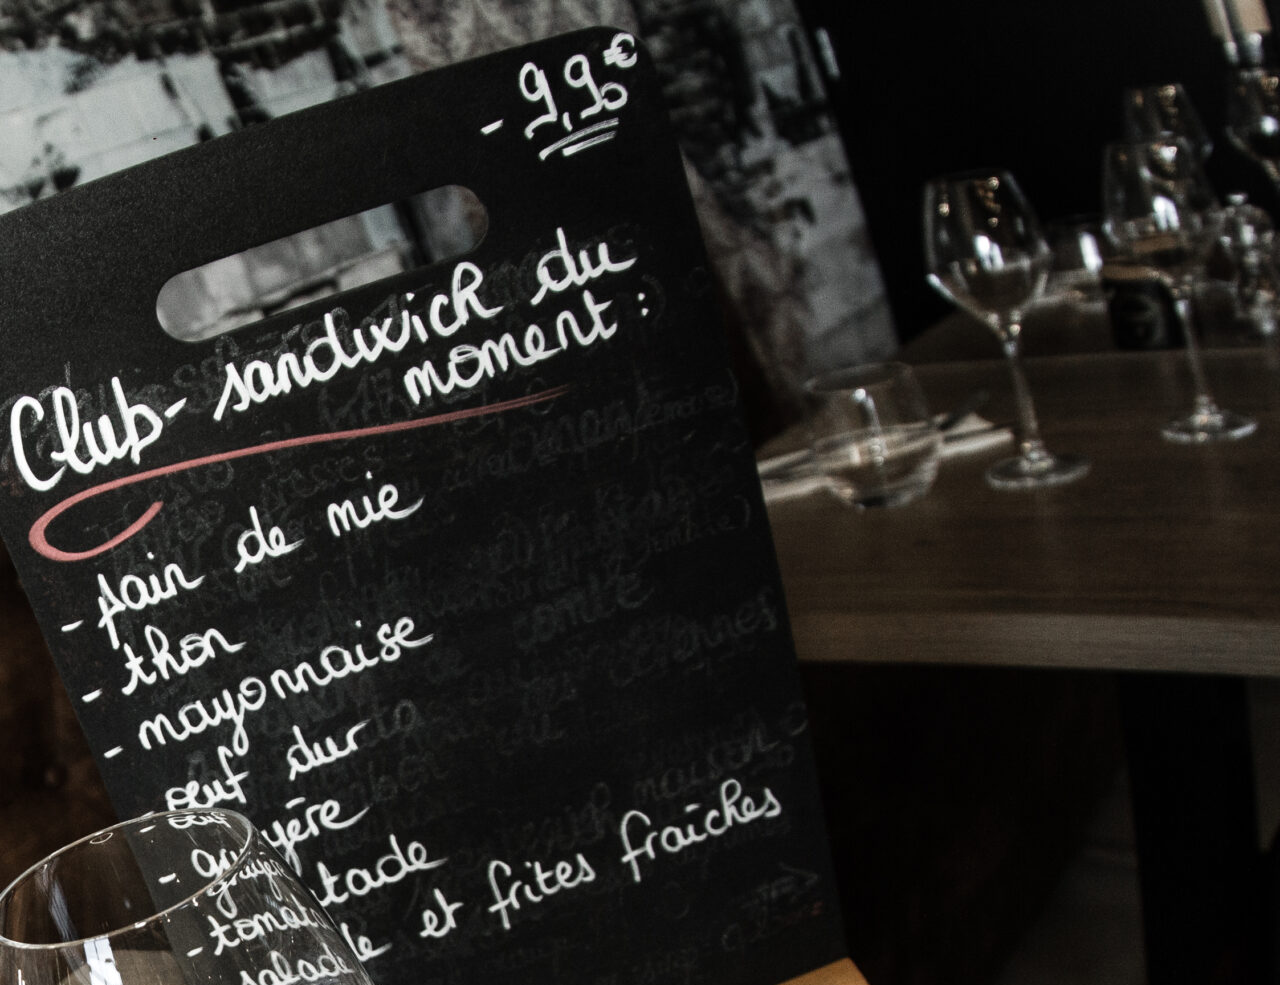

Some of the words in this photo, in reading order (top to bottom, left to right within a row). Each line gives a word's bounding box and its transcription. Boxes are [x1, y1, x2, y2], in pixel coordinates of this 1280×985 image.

[519, 32, 638, 140] 9,90€
[531, 227, 638, 306] du
[97, 551, 205, 651] pain
[234, 505, 305, 574] de
[327, 470, 425, 537] mie
[121, 624, 247, 696] thon
[138, 615, 435, 757] mayonnaise
[285, 726, 372, 782] dur
[420, 888, 464, 938] et
[488, 860, 596, 930] frites
